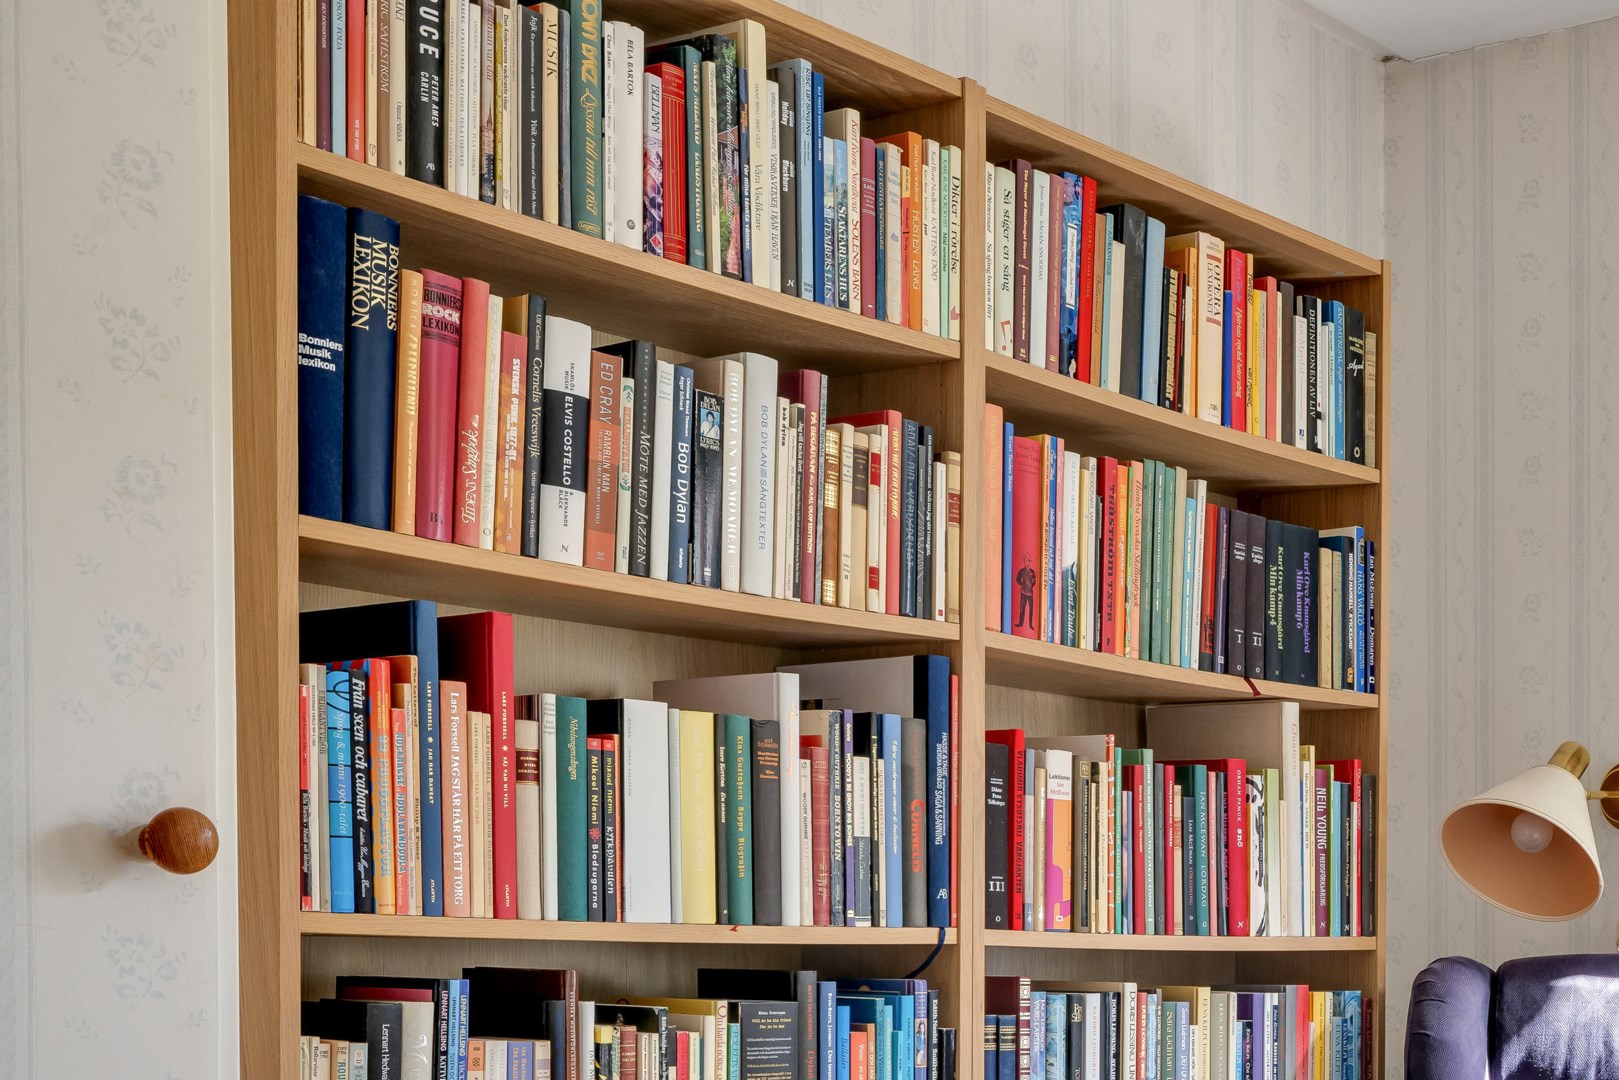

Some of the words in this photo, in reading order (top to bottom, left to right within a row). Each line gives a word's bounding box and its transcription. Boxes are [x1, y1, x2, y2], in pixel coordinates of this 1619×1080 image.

[547, 20, 557, 79] MUSIK
[627, 40, 635, 59] BÉLA
[420, 72, 428, 102] CARLIN
[627, 61, 635, 96] BARTÓK
[581, 89, 598, 133] Lyssna
[586, 136, 598, 160] till
[586, 158, 598, 186] min
[755, 164, 763, 184] Våra
[755, 186, 763, 230] Visdiktare
[950, 175, 960, 218] Dikter
[1003, 188, 1012, 203] Så
[1001, 209, 1011, 242] stiger
[852, 219, 860, 266] SOLENS
[951, 230, 960, 274] rörelse
[1003, 245, 1010, 260] en
[351, 233, 372, 330] LEXIKON
[371, 237, 387, 308] MUSIK
[386, 244, 400, 330] BONNIERS
[852, 269, 860, 300] BARN
[1001, 264, 1011, 292] sång
[424, 288, 461, 311] BONNIERS
[1213, 264, 1221, 316] OPERA
[422, 302, 460, 324] ROCK
[423, 318, 460, 337] LEXIKON
[299, 333, 343, 352] Bonniers
[299, 344, 331, 360] Musik
[299, 356, 336, 372] lexikon
[600, 362, 614, 381] ED
[532, 358, 542, 402] Cornelis
[1310, 386, 1315, 399] AV
[564, 396, 573, 425] ELVIS
[599, 386, 614, 424] CRAY
[530, 406, 541, 458] Vreeswijk
[563, 429, 572, 486] COSTELLO
[678, 442, 689, 474] Bob
[760, 432, 768, 467] DYLAN
[602, 473, 610, 492] MAN
[673, 479, 688, 523] Dylan
[758, 479, 768, 550] SÅNGTEXTER
[1296, 569, 1304, 594] Min
[1295, 595, 1304, 622] kamp
[352, 678, 366, 708] Från
[450, 692, 459, 713] Lars
[353, 713, 366, 741] scen
[451, 716, 460, 752] Forssell
[355, 746, 367, 768] och
[451, 755, 460, 777] JAG
[356, 771, 369, 821] cabaret
[451, 778, 461, 806] STÅR
[452, 808, 462, 833] HÄR
[737, 806, 745, 832] Beppe
[1317, 815, 1327, 849] YOUNG
[453, 835, 463, 850] PÅ
[454, 852, 463, 872] ETT
[590, 844, 599, 908] Blodsugarna
[454, 874, 463, 905] TORG
[440, 991, 448, 1019] LENNART
[382, 1024, 390, 1053] Lennart
[440, 1020, 448, 1051] HELLSING
